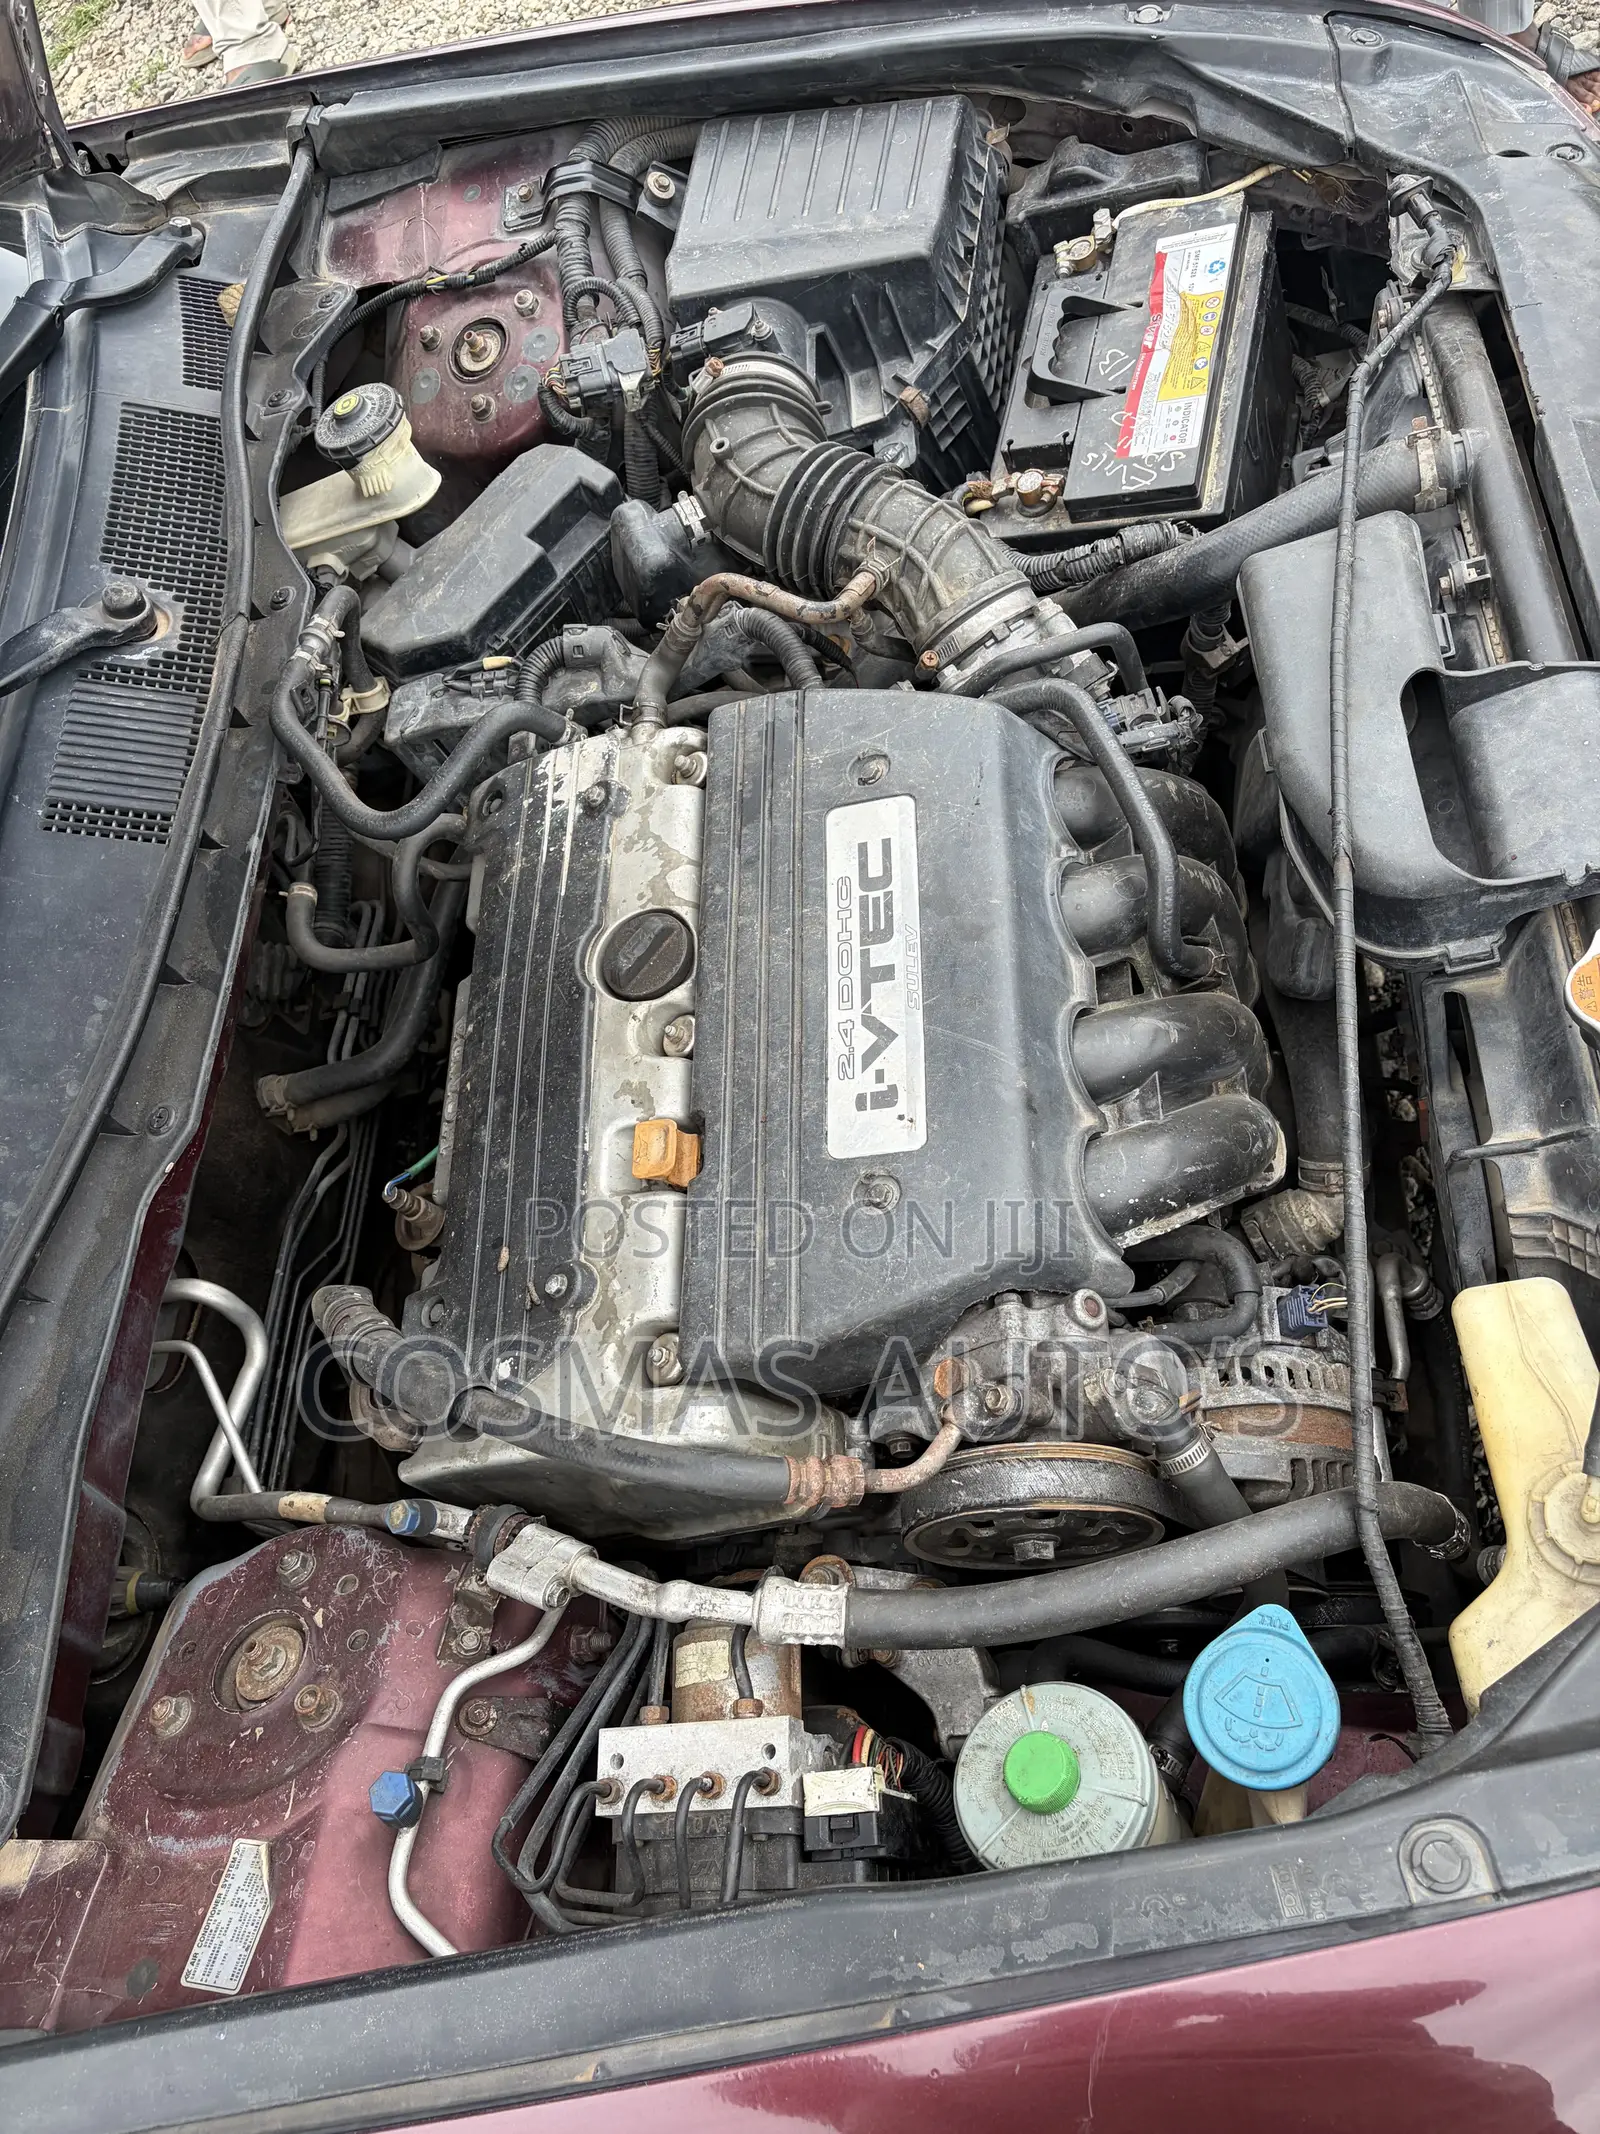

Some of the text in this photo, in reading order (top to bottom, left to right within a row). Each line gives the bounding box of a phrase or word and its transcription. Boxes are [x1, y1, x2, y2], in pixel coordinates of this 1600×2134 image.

[1177, 401, 1192, 445] INDICATOR
[837, 876, 855, 1081] 2.4 DOHC
[855, 837, 899, 1112] i-VTEC
[905, 924, 921, 1011] SULEV
[1577, 975, 1595, 1000] 警告
[189, 1855, 238, 1966] AIR CONDITIONER SYSTEM
